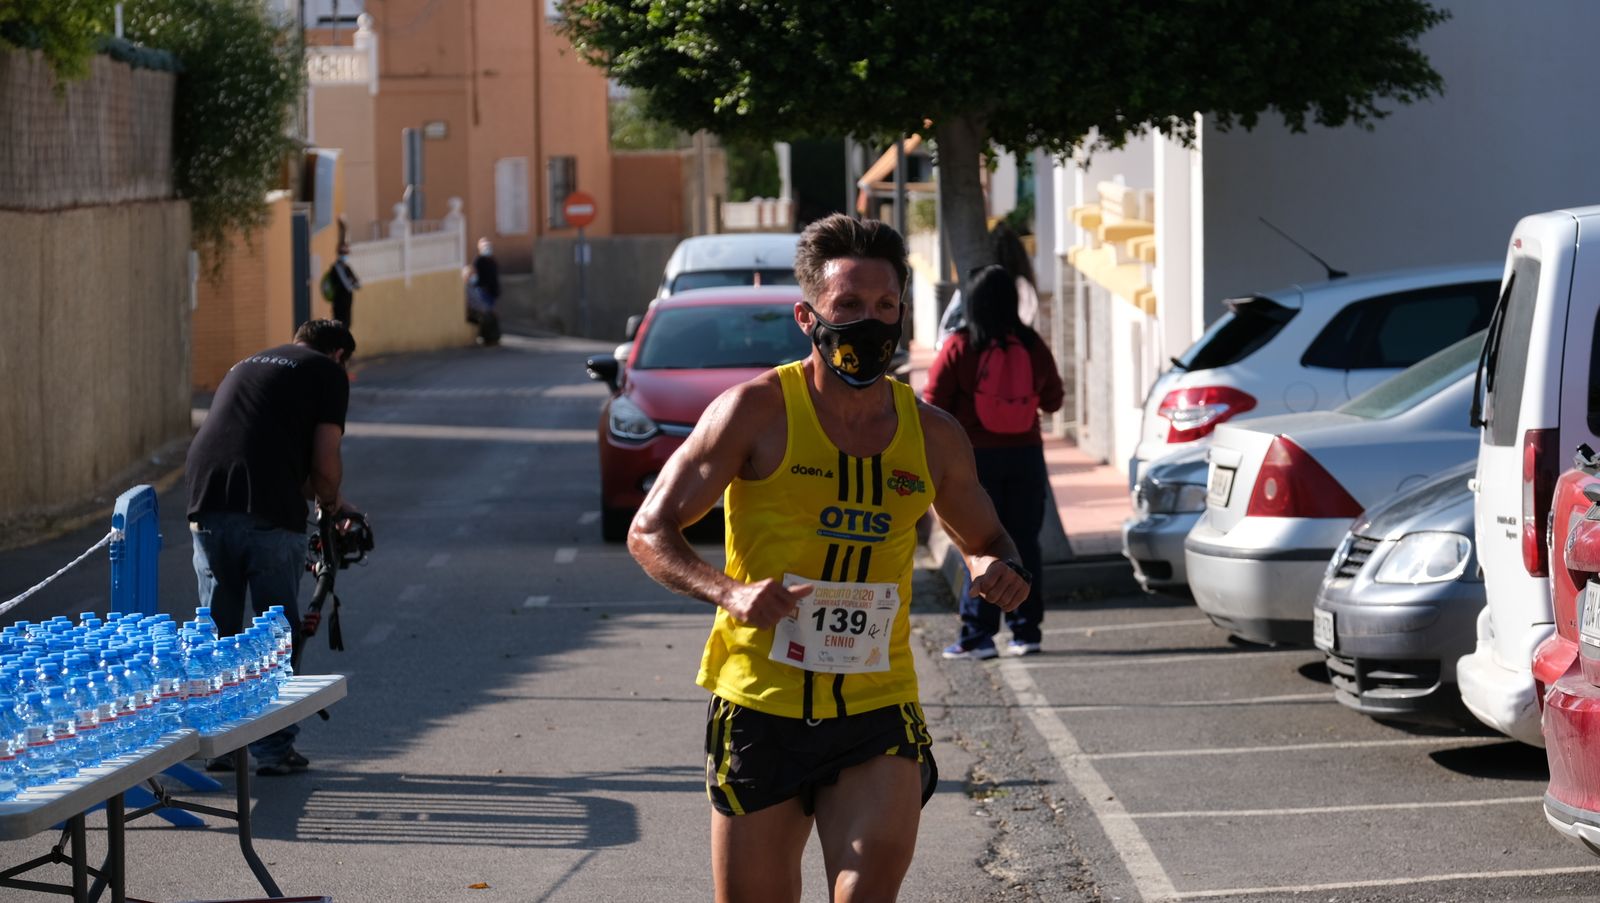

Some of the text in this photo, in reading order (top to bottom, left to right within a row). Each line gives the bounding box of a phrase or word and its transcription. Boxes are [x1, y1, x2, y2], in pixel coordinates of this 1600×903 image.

[791, 463, 822, 477] daen
[820, 506, 892, 534] OTIS
[811, 607, 867, 635] 139
[824, 635, 855, 648] ENNIO
